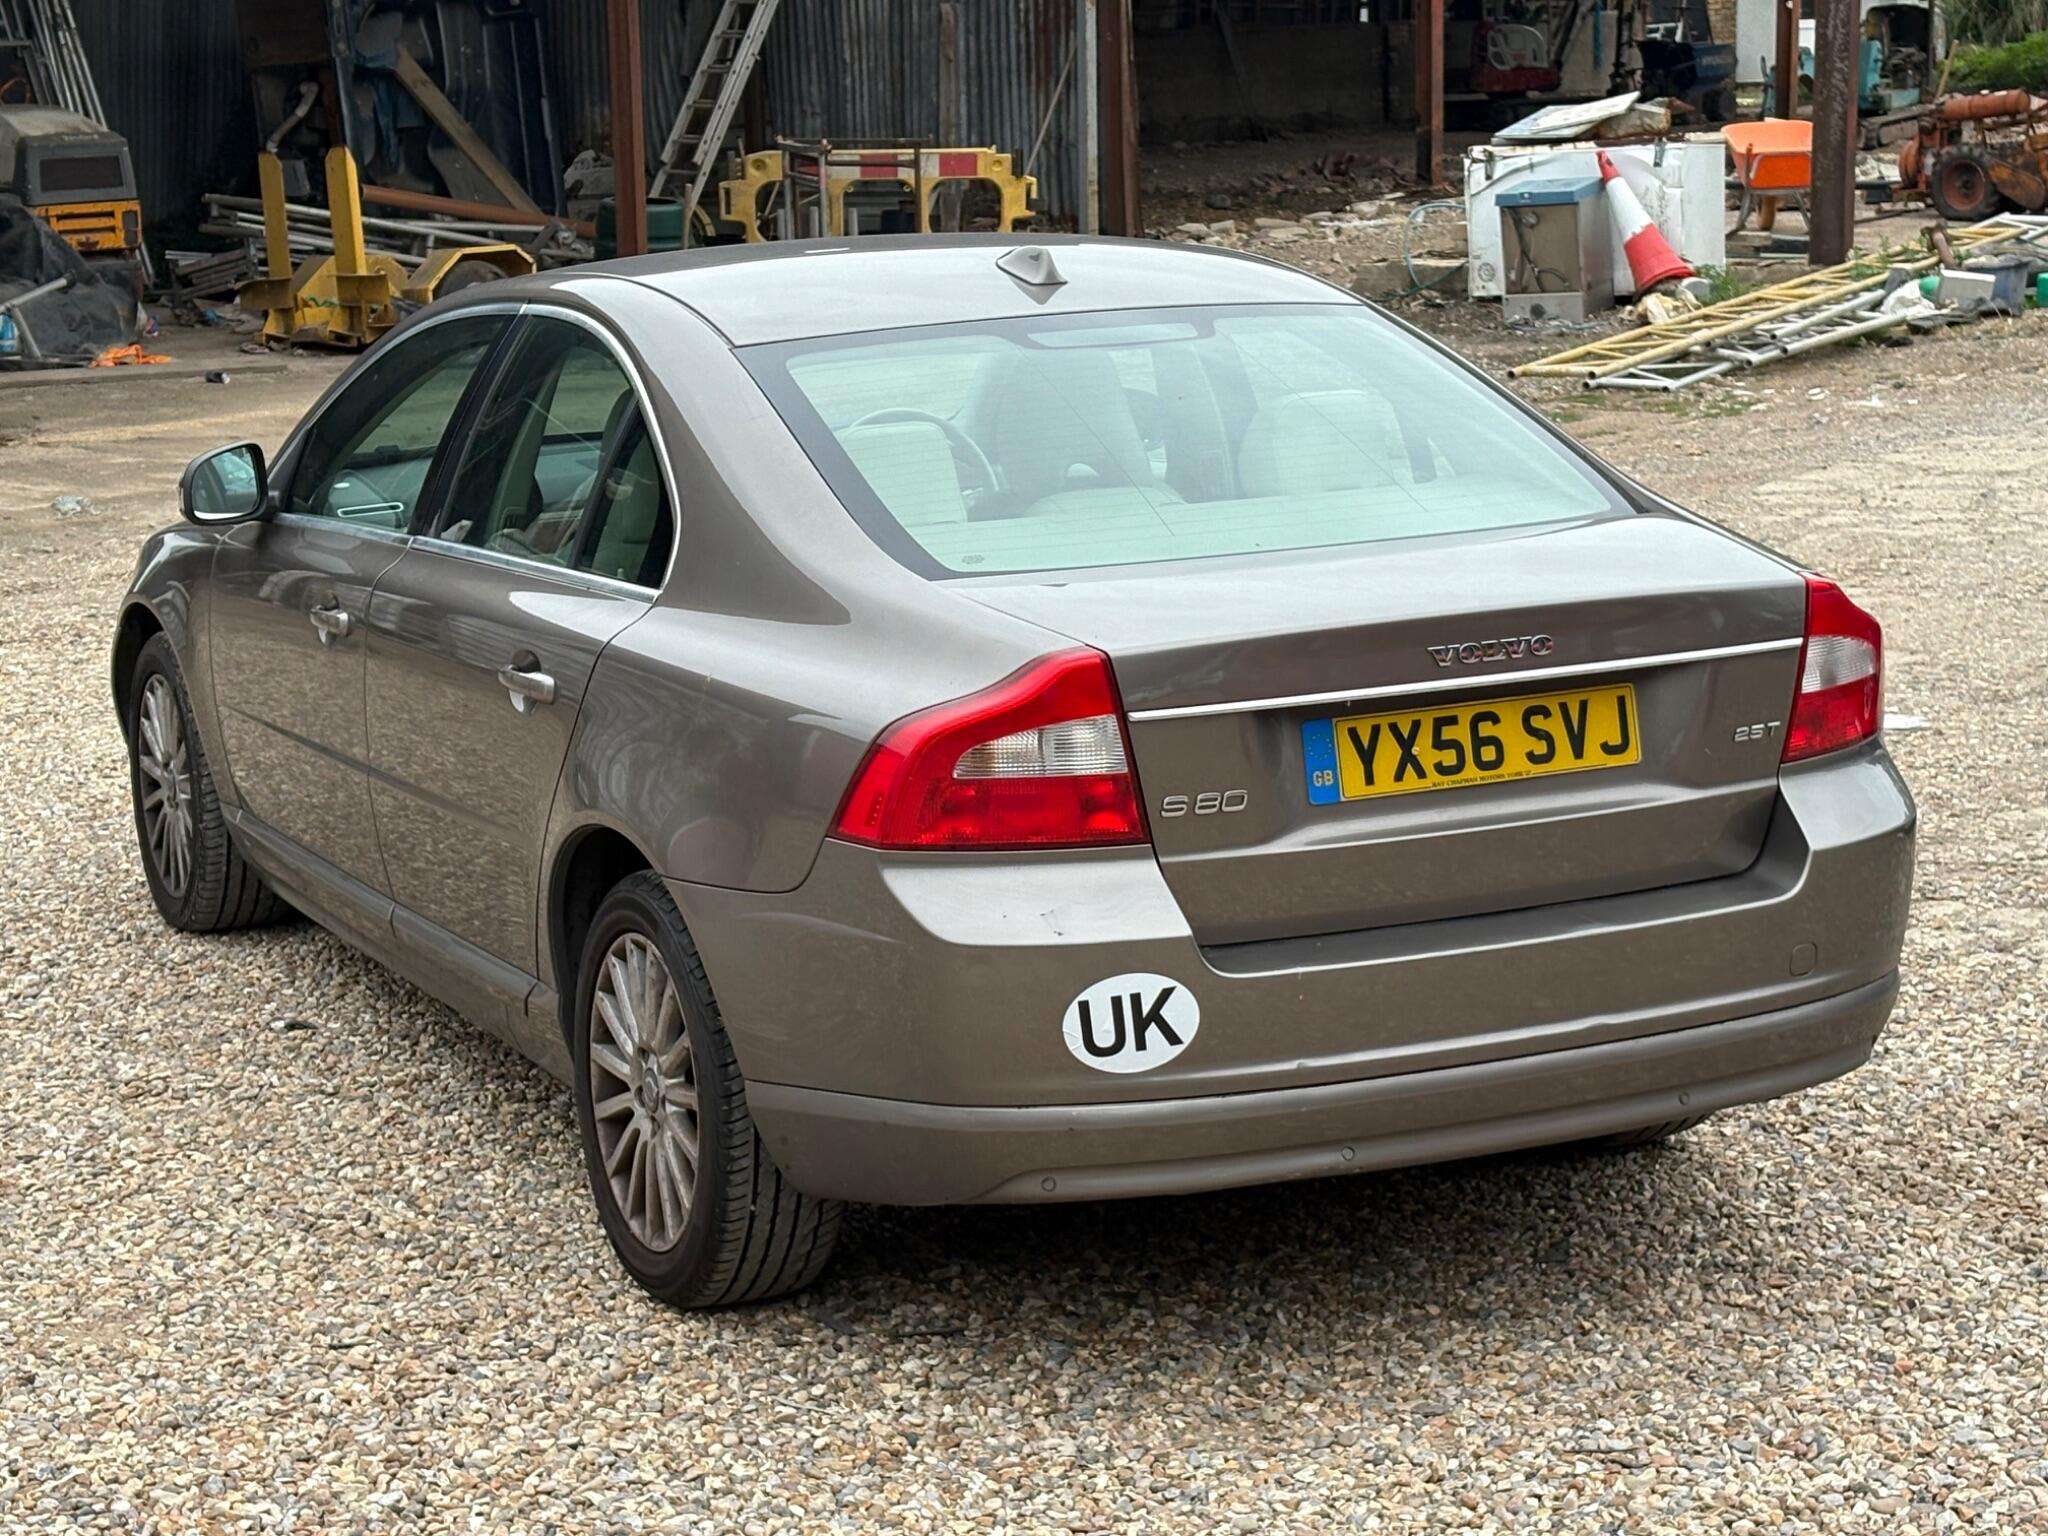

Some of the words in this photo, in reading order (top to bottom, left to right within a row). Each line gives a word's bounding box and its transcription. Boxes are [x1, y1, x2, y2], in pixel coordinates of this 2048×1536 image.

[1427, 634, 1553, 667] VOLVO
[1346, 710, 1505, 787] YX56
[1520, 695, 1631, 766] SVJ
[1312, 770, 1334, 787] GB
[1479, 772, 1505, 782] MOTORS
[1077, 985, 1184, 1058] UK
